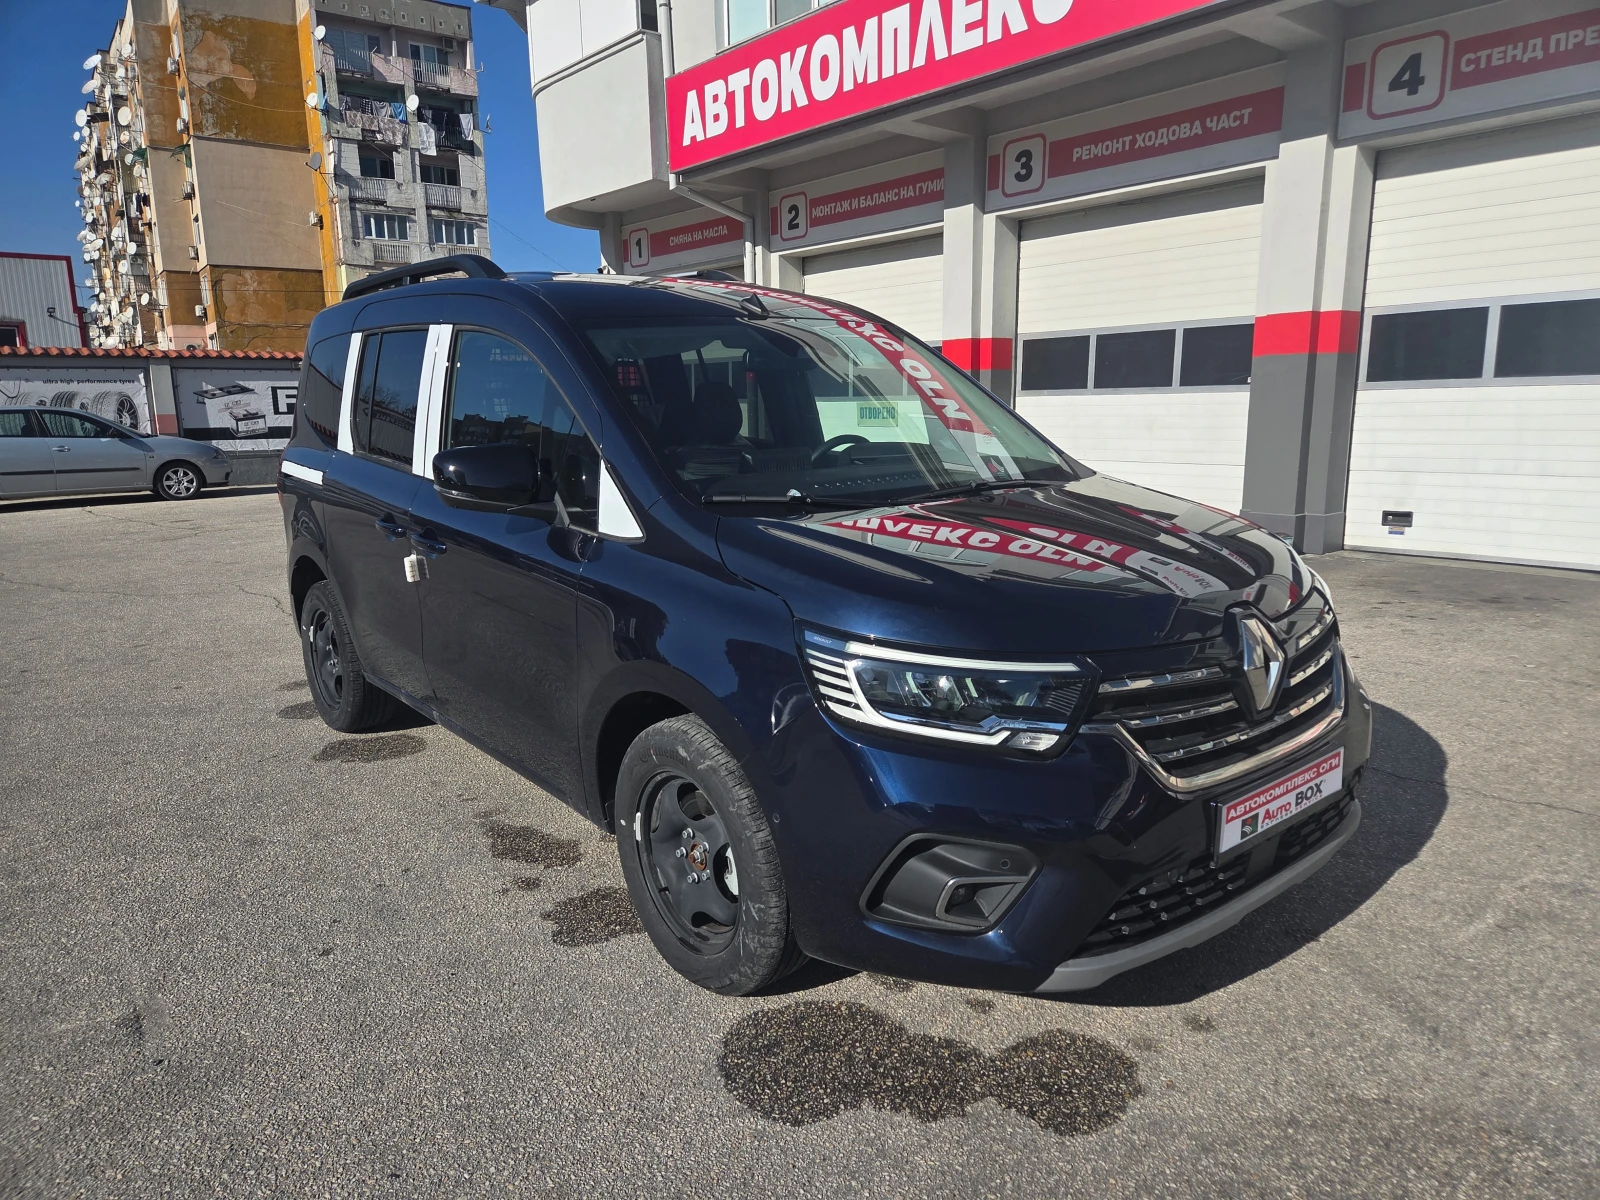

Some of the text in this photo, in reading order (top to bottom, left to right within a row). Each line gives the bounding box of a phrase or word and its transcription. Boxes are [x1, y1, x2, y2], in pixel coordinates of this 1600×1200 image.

[1460, 38, 1544, 73] СТЕНД
[1388, 52, 1425, 96] 4
[1072, 108, 1252, 162] РЕМОНТ ХОДОВА ЧАСТ
[1014, 149, 1033, 183] 3
[812, 178, 944, 218] МОНТАЖ И БАЛАНС НА ГУМИ
[787, 203, 800, 231] 2
[635, 237, 643, 259] 1
[669, 224, 728, 246] СМЯНА НА МАСЛА
[860, 406, 896, 420] ОТВОРЕНО
[1228, 757, 1339, 820] АВТОКОМПЛЕКС ОГИ
[1295, 780, 1323, 807] BOX
